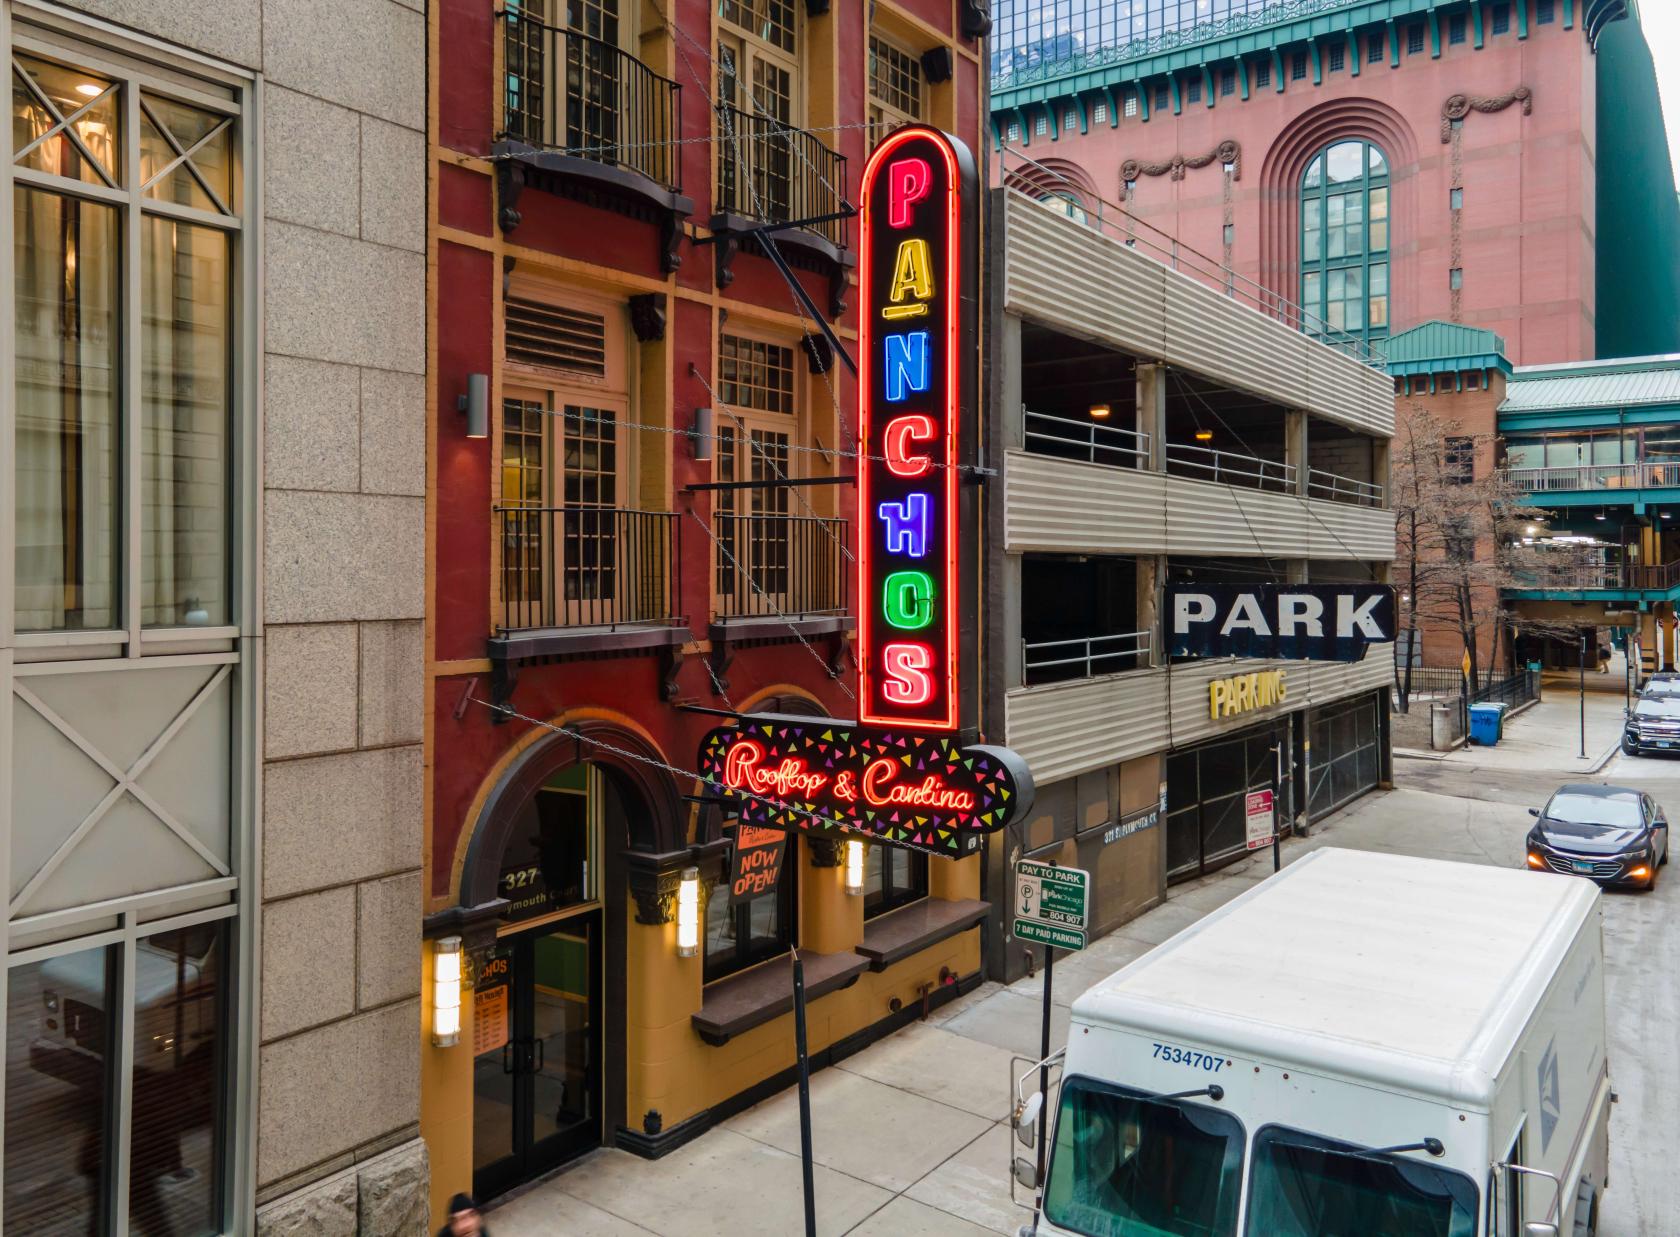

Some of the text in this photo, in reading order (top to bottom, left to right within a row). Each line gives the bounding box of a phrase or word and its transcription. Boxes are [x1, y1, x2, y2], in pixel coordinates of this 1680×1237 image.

[879, 157, 936, 705] PANCHOS
[1174, 593, 1387, 638] PARK
[1209, 669, 1288, 720] PARKING
[725, 741, 976, 810] Rooftop & Cantina
[740, 848, 778, 875] NOW
[1021, 864, 1081, 884] PAY TO PARK
[505, 867, 538, 890] 327
[734, 866, 778, 896] OPEN!
[1049, 911, 1065, 921] 804
[1066, 915, 1081, 925] 907
[1016, 923, 1082, 946] 7 DAY PAID PARKING
[1153, 1043, 1225, 1073] 7534707
